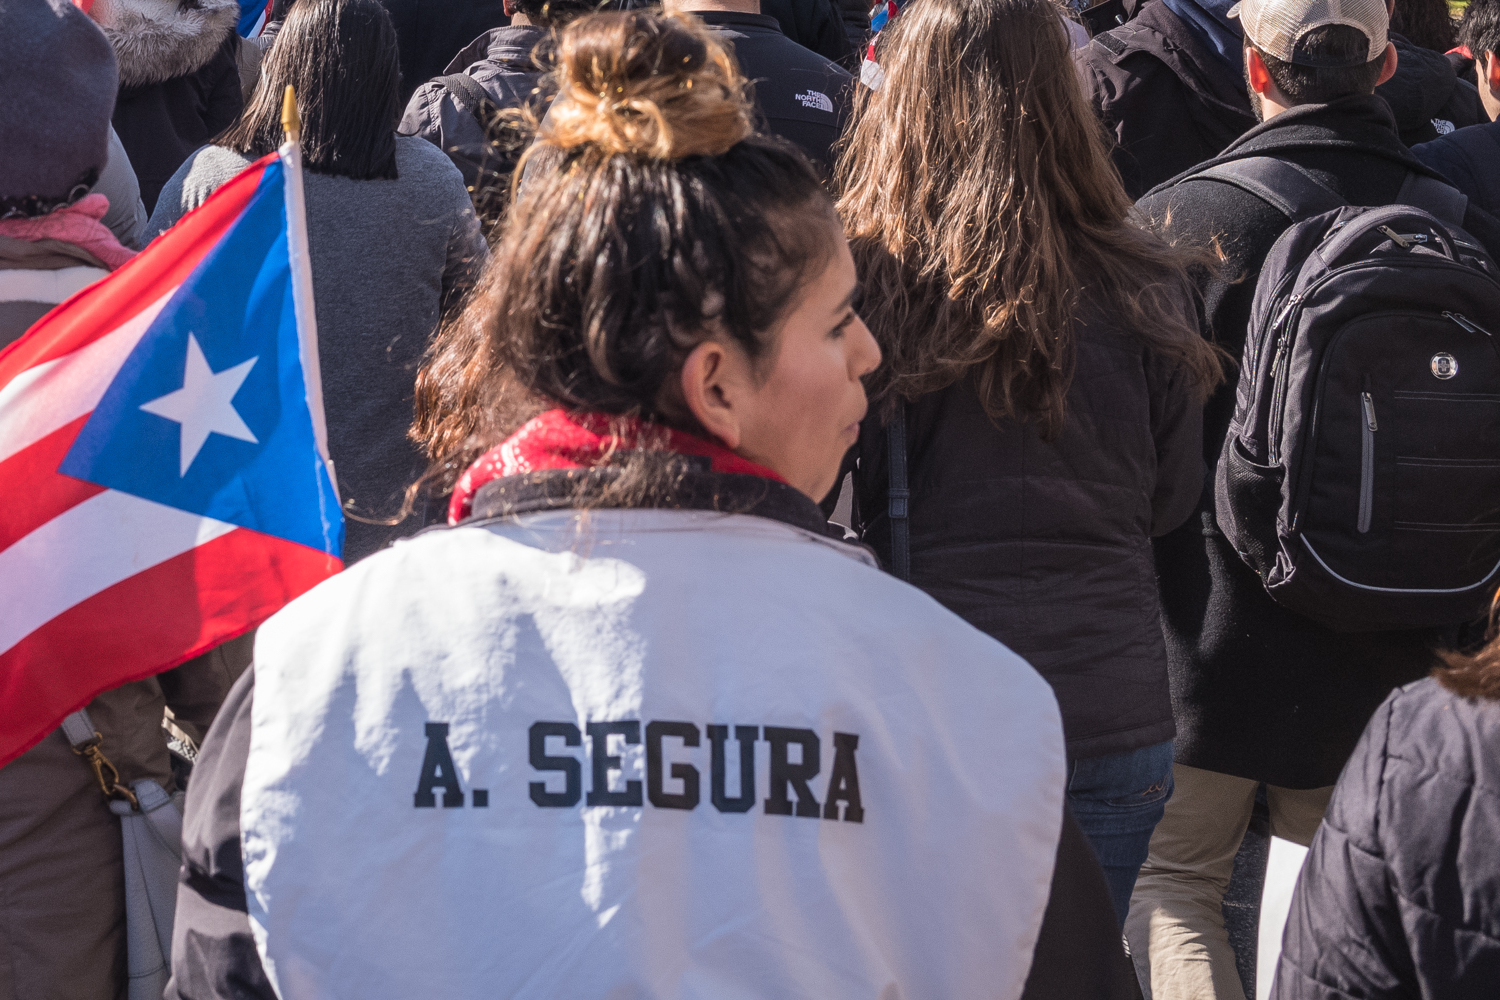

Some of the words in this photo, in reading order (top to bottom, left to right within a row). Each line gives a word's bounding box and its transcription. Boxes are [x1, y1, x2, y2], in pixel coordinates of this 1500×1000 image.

[794, 93, 821, 103] NORTH
[802, 100, 821, 109] FACE
[414, 721, 489, 808] A.
[528, 719, 865, 825] SEGURA
